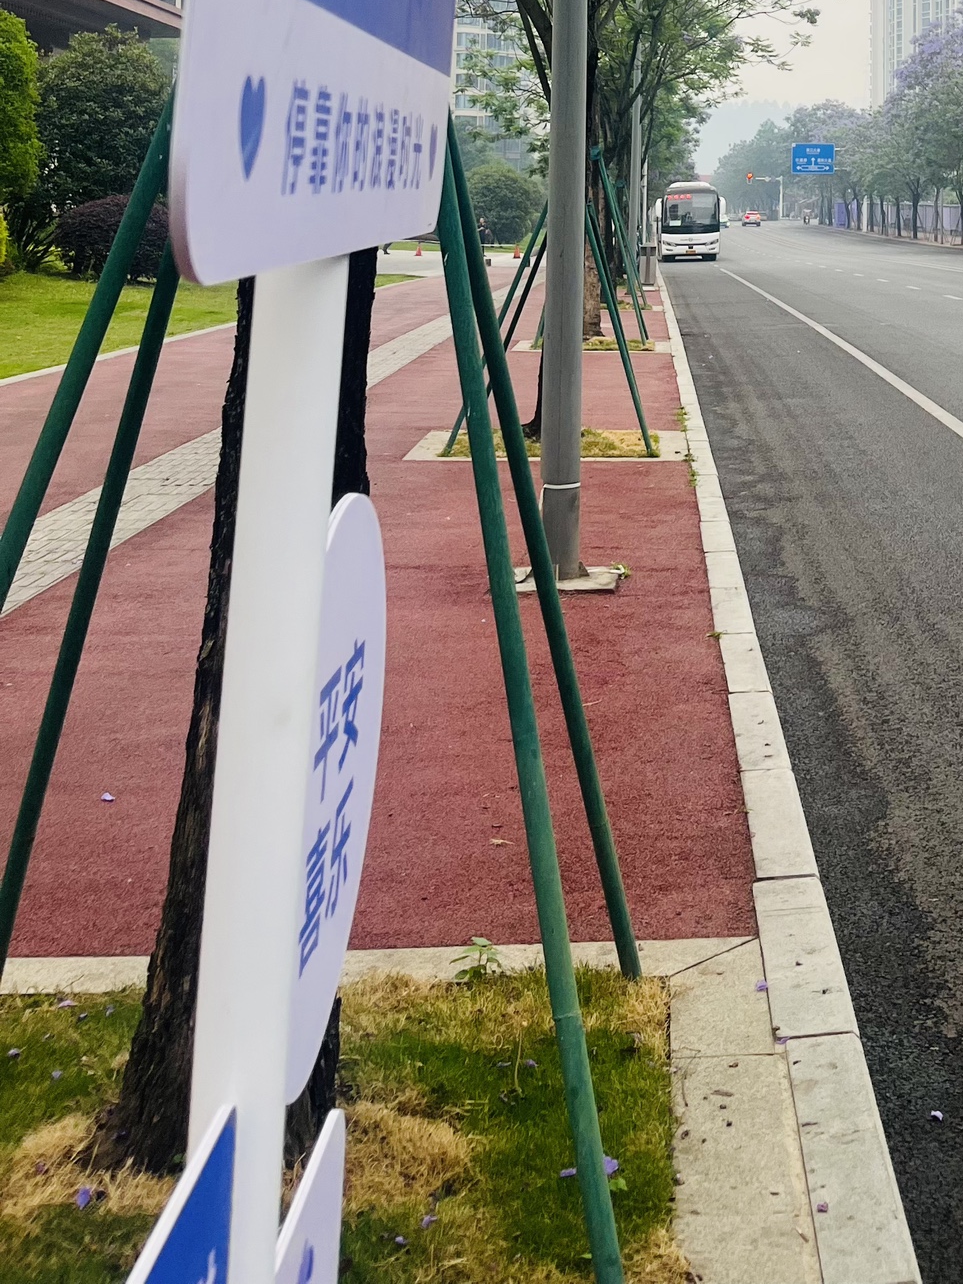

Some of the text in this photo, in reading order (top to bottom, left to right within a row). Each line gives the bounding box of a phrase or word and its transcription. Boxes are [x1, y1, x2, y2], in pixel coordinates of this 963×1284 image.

[281, 78, 424, 196] 停靠你的浪漫时光
